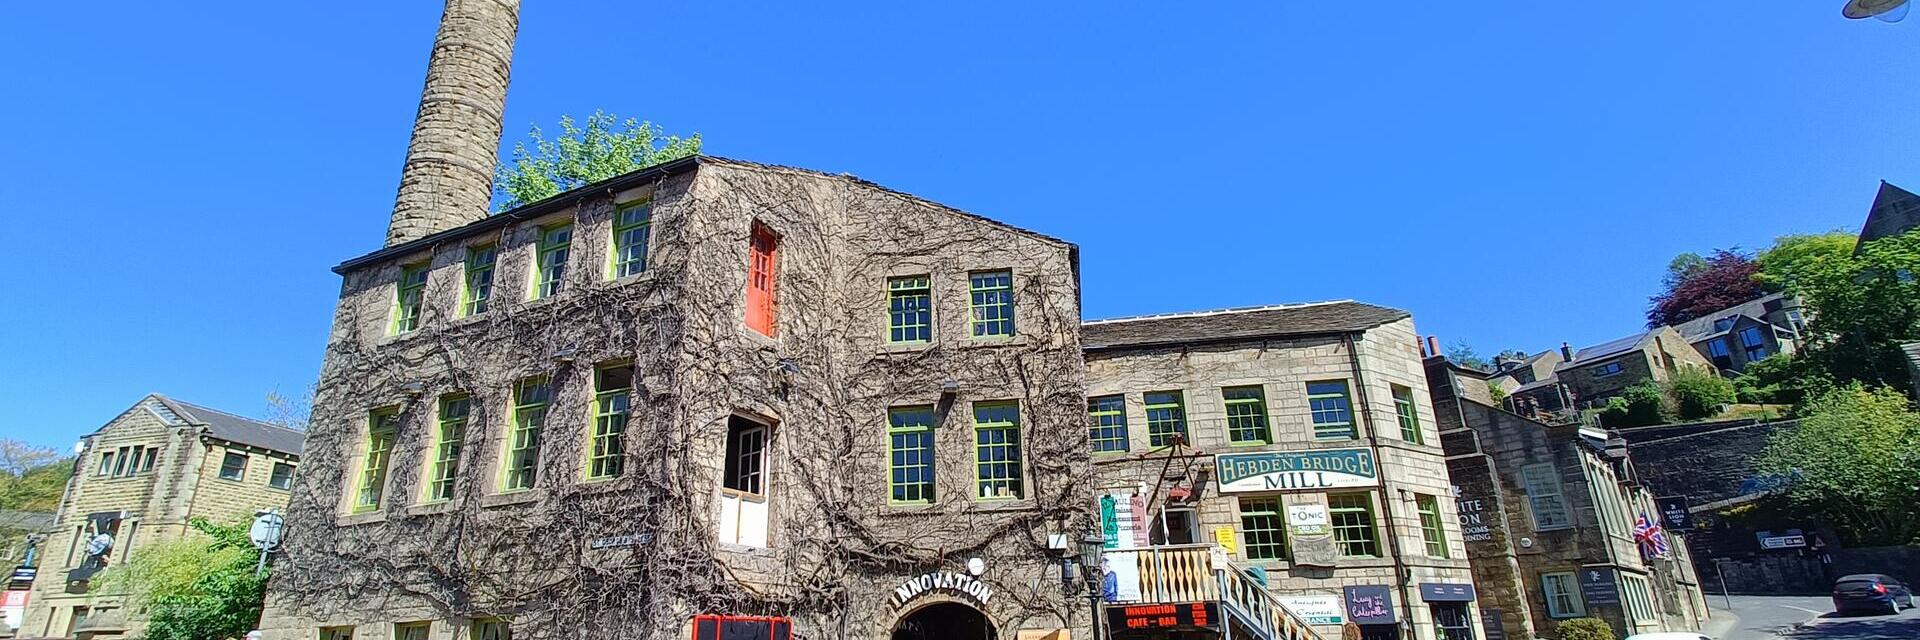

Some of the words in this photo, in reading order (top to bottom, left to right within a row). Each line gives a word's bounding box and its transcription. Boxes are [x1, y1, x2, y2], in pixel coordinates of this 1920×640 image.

[1221, 458, 1294, 482] HEBDEN
[1301, 452, 1372, 476] BRIDGE
[1264, 472, 1332, 489] MILL
[1291, 511, 1323, 520] TONIC
[893, 571, 994, 606] INNOVATION
[1125, 604, 1177, 616] INNOVATION
[1127, 618, 1149, 628] CAFE
